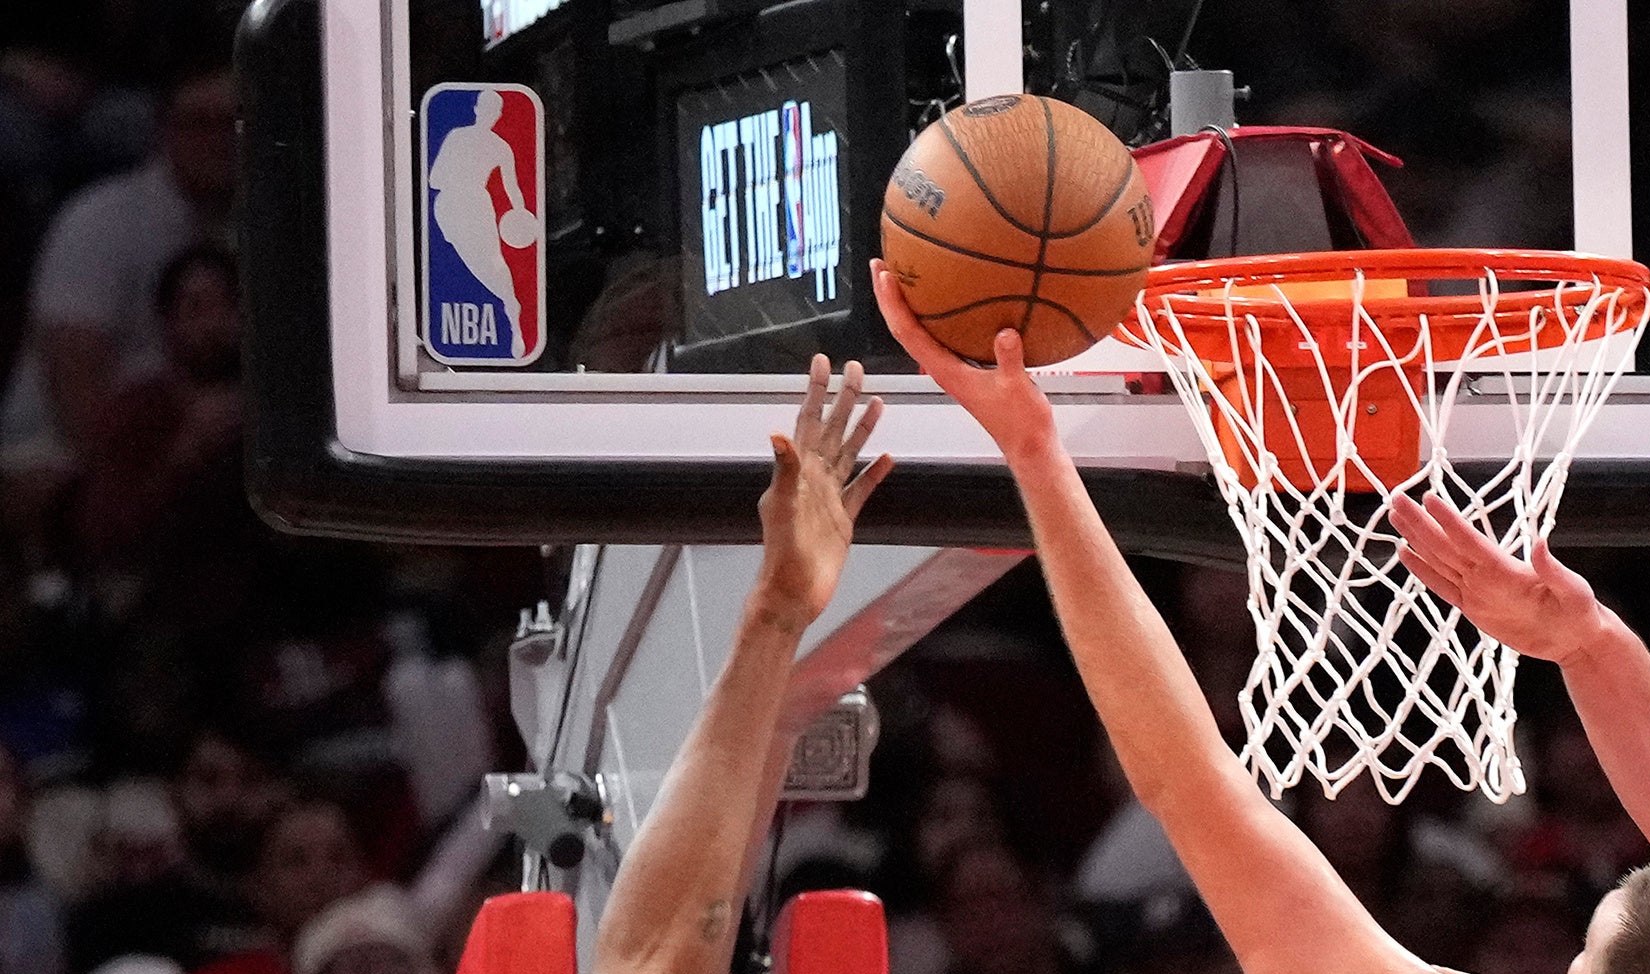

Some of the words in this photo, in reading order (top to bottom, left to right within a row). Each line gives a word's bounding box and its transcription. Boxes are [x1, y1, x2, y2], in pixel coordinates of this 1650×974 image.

[700, 123, 740, 297] GET
[739, 109, 785, 284] THE
[440, 302, 498, 346] NBA
